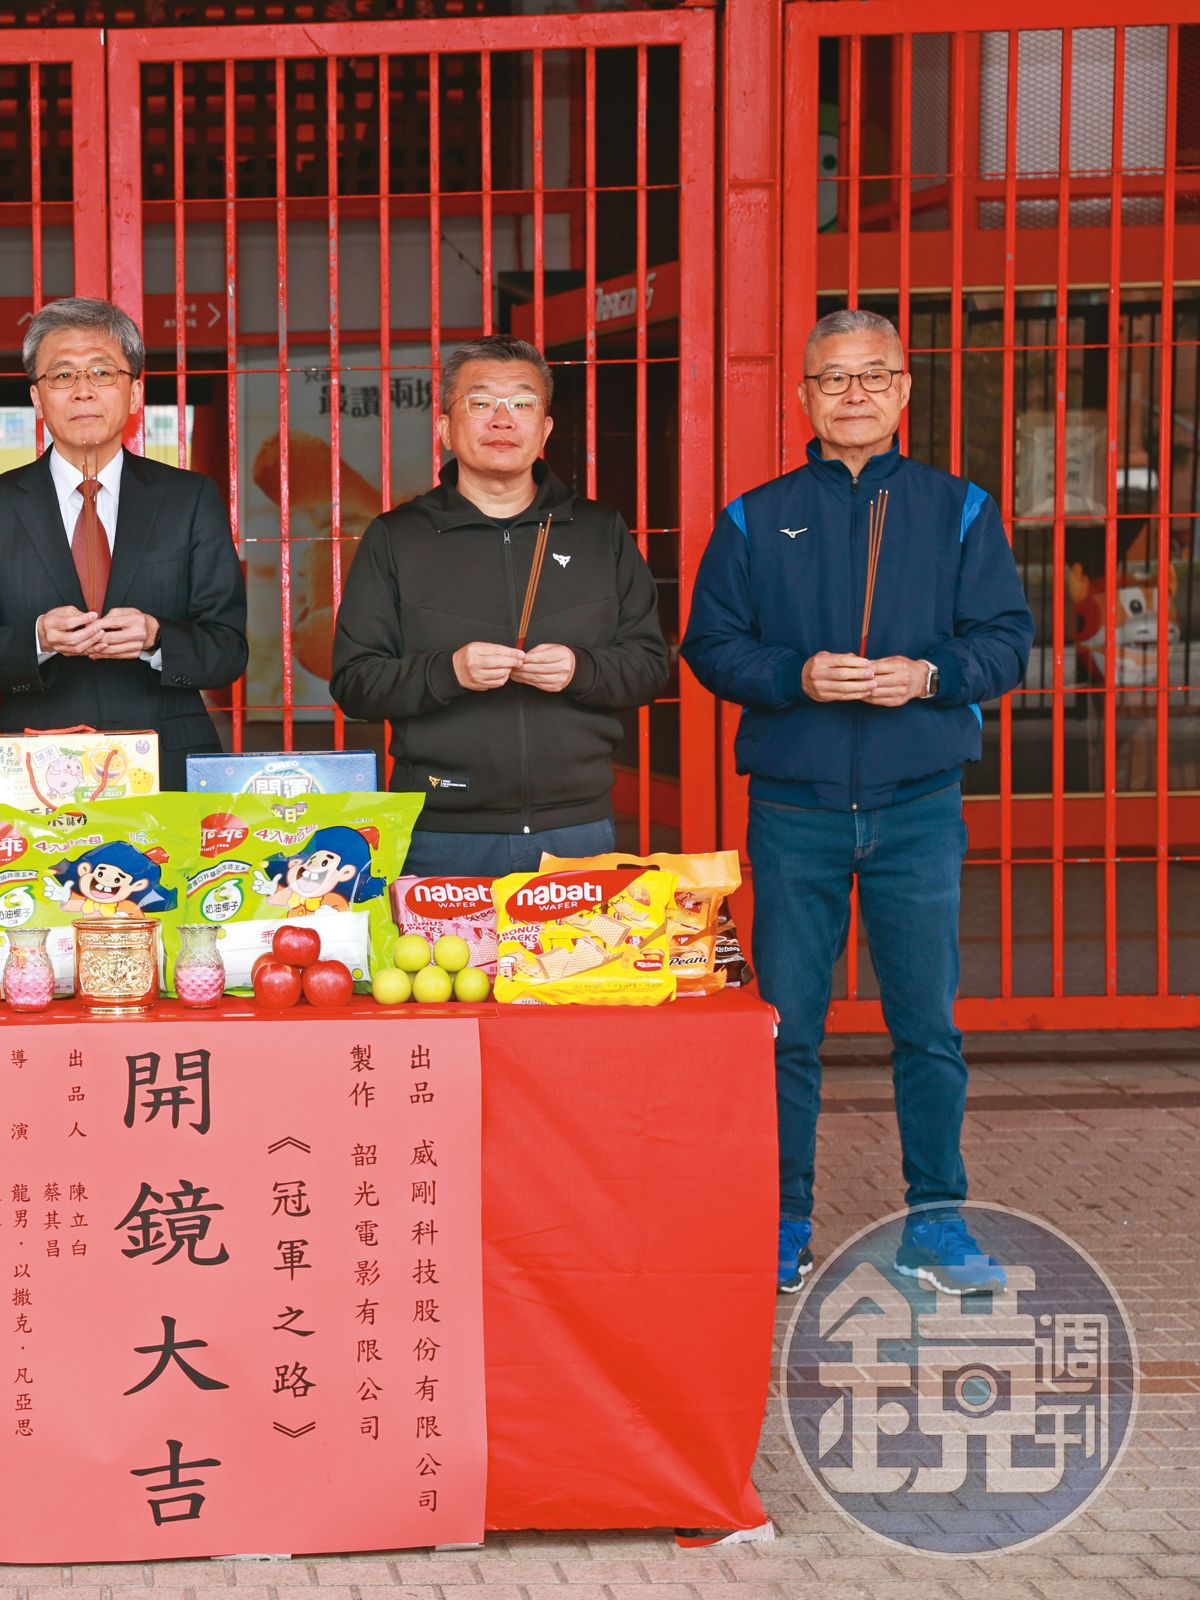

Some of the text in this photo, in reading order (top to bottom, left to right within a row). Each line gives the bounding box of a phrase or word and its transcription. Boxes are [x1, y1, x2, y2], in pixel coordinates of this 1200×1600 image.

[205, 900, 239, 914] 奶油椰子
[414, 883, 492, 903] nabat
[517, 881, 603, 906] nabati
[538, 901, 579, 911] WAFER
[11, 1049, 29, 1140] 導演
[68, 1049, 89, 1256] 出品人 陳立白
[44, 1183, 62, 1258] 蔡其昌
[349, 1044, 384, 1441] 製作 韶光電影有限公司
[113, 1048, 230, 1527] 開鏡大吉
[267, 1135, 317, 1439] 《冠軍之路》
[410, 1044, 442, 1513] 出品 威剛科技股份有限公司
